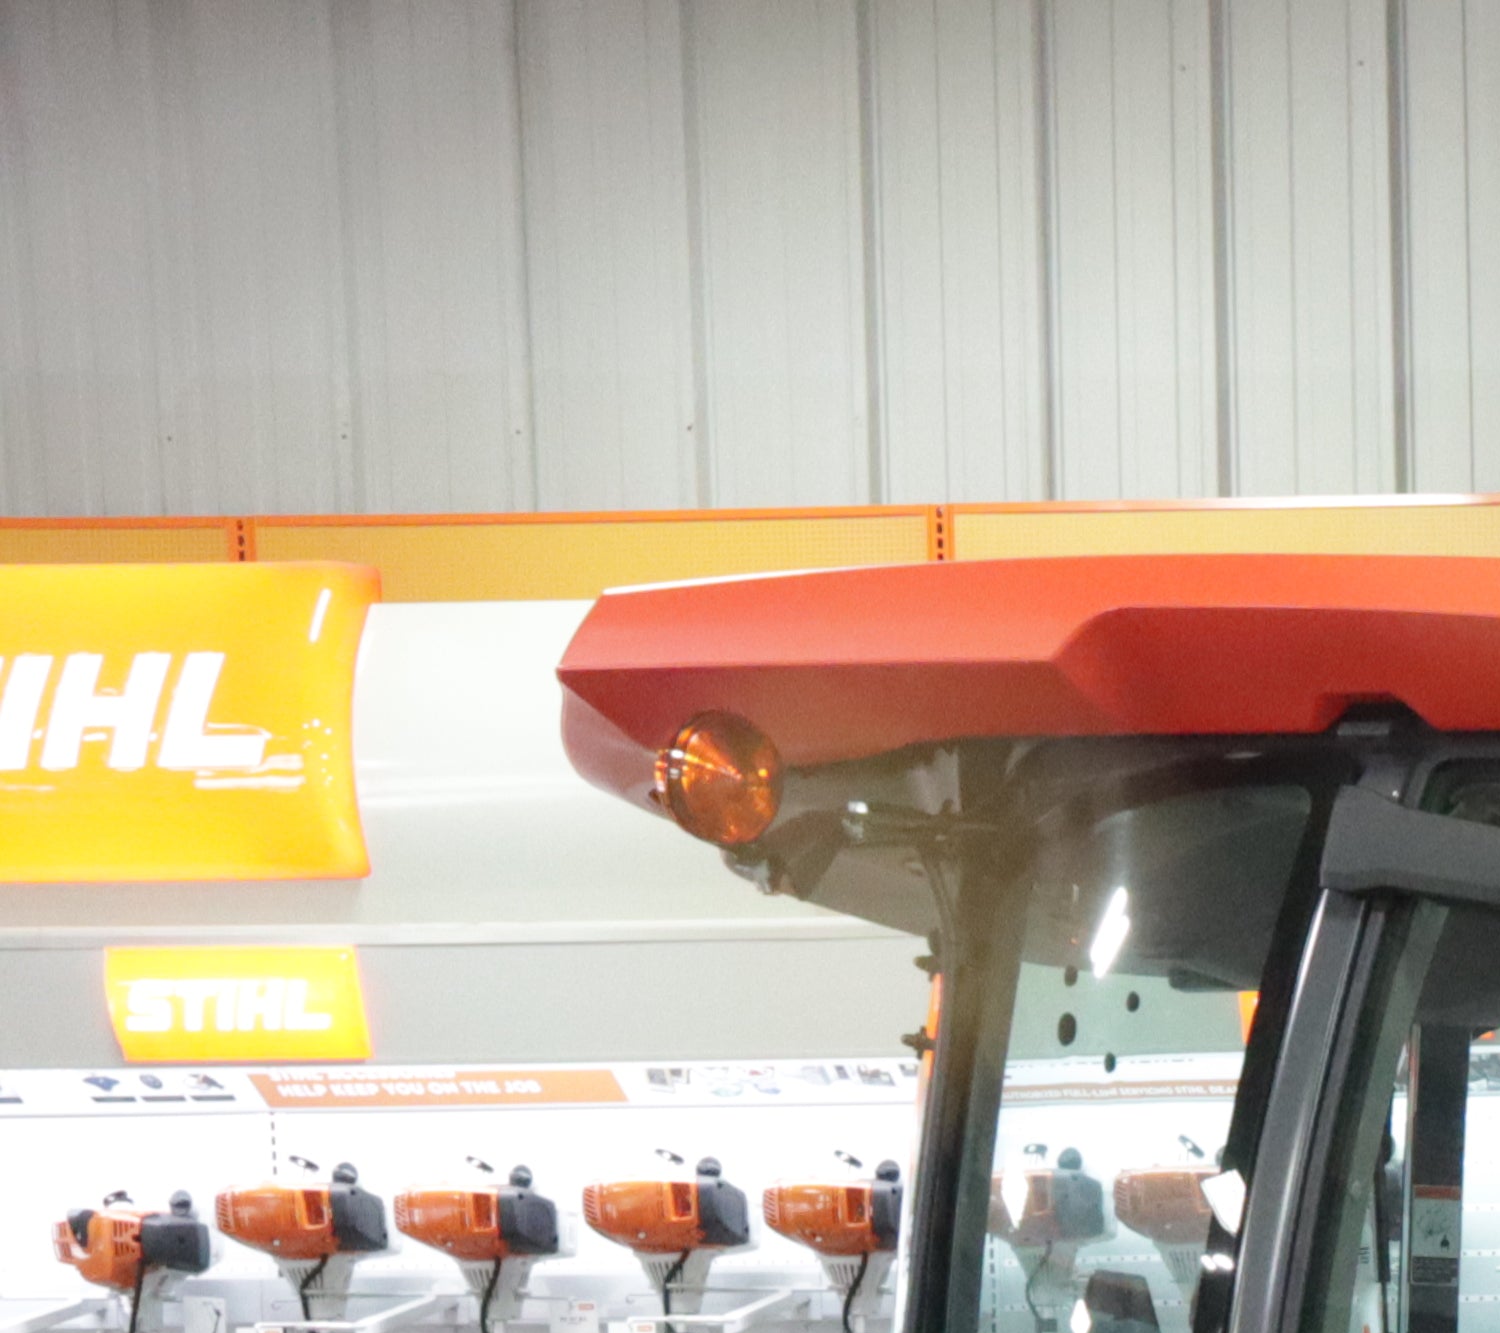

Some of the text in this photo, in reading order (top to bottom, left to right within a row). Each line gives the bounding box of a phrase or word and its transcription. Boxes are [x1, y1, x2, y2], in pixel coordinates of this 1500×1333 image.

[125, 978, 332, 1033] STIHL
[277, 1080, 541, 1097] HELP KEEP YOU ON THE JOB
